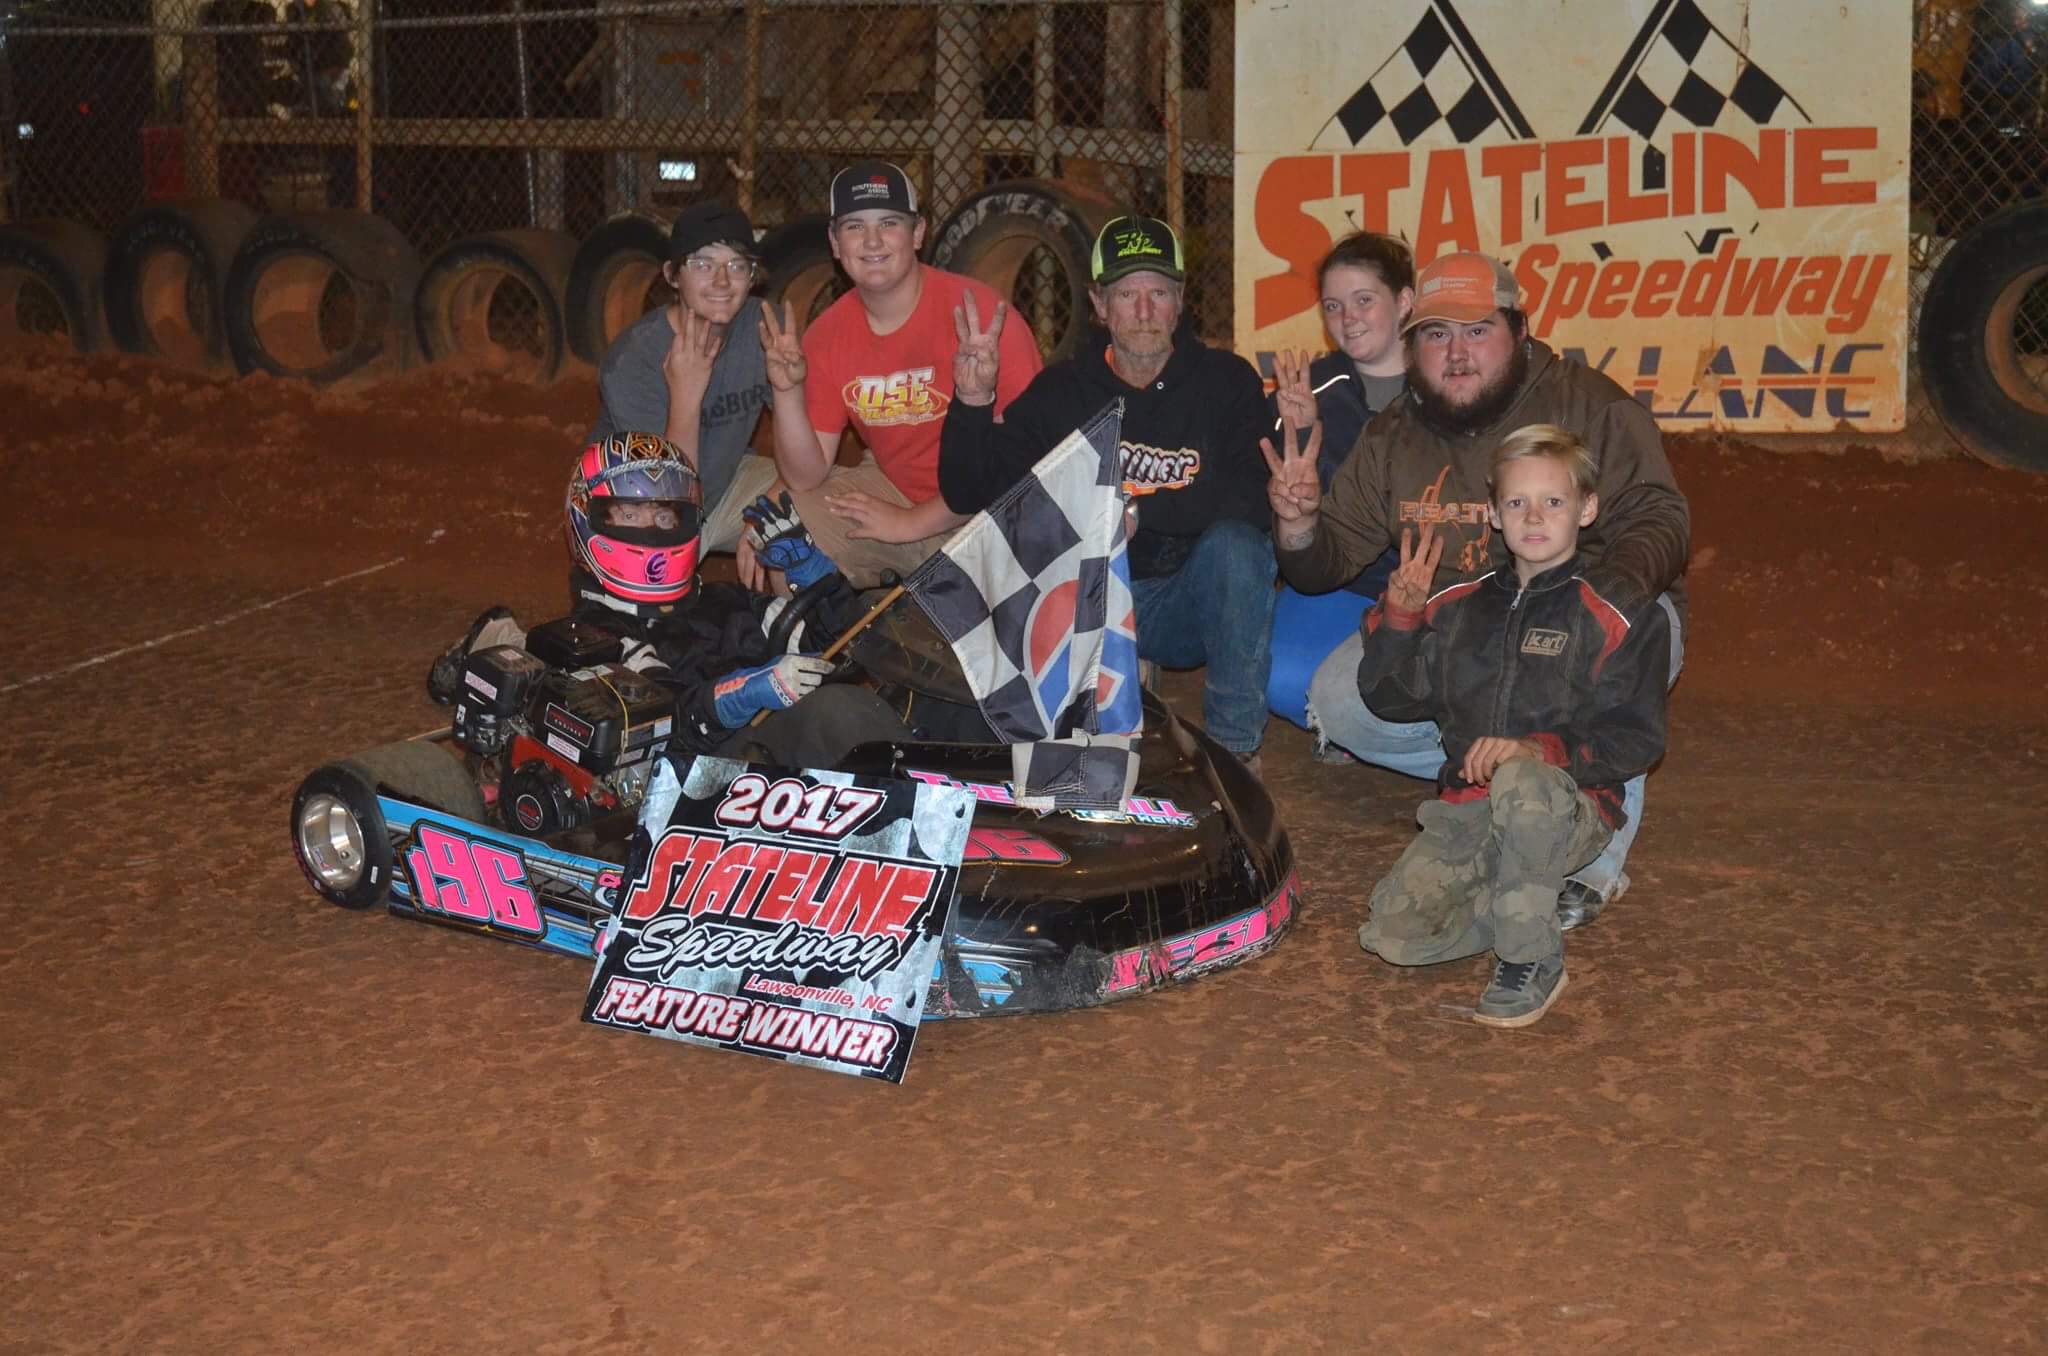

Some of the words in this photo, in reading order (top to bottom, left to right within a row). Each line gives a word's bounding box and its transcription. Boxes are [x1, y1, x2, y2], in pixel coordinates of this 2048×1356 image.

[1254, 127, 1879, 330] STATELINE
[1514, 238, 1892, 337] Speedway
[717, 774, 885, 840] 2017
[408, 827, 543, 932] 196
[624, 834, 939, 943] STATELINE
[626, 916, 904, 980] Speedway
[598, 977, 744, 1038] FEATURE
[743, 1003, 899, 1067] WINNER
[861, 995, 893, 1012] NC
